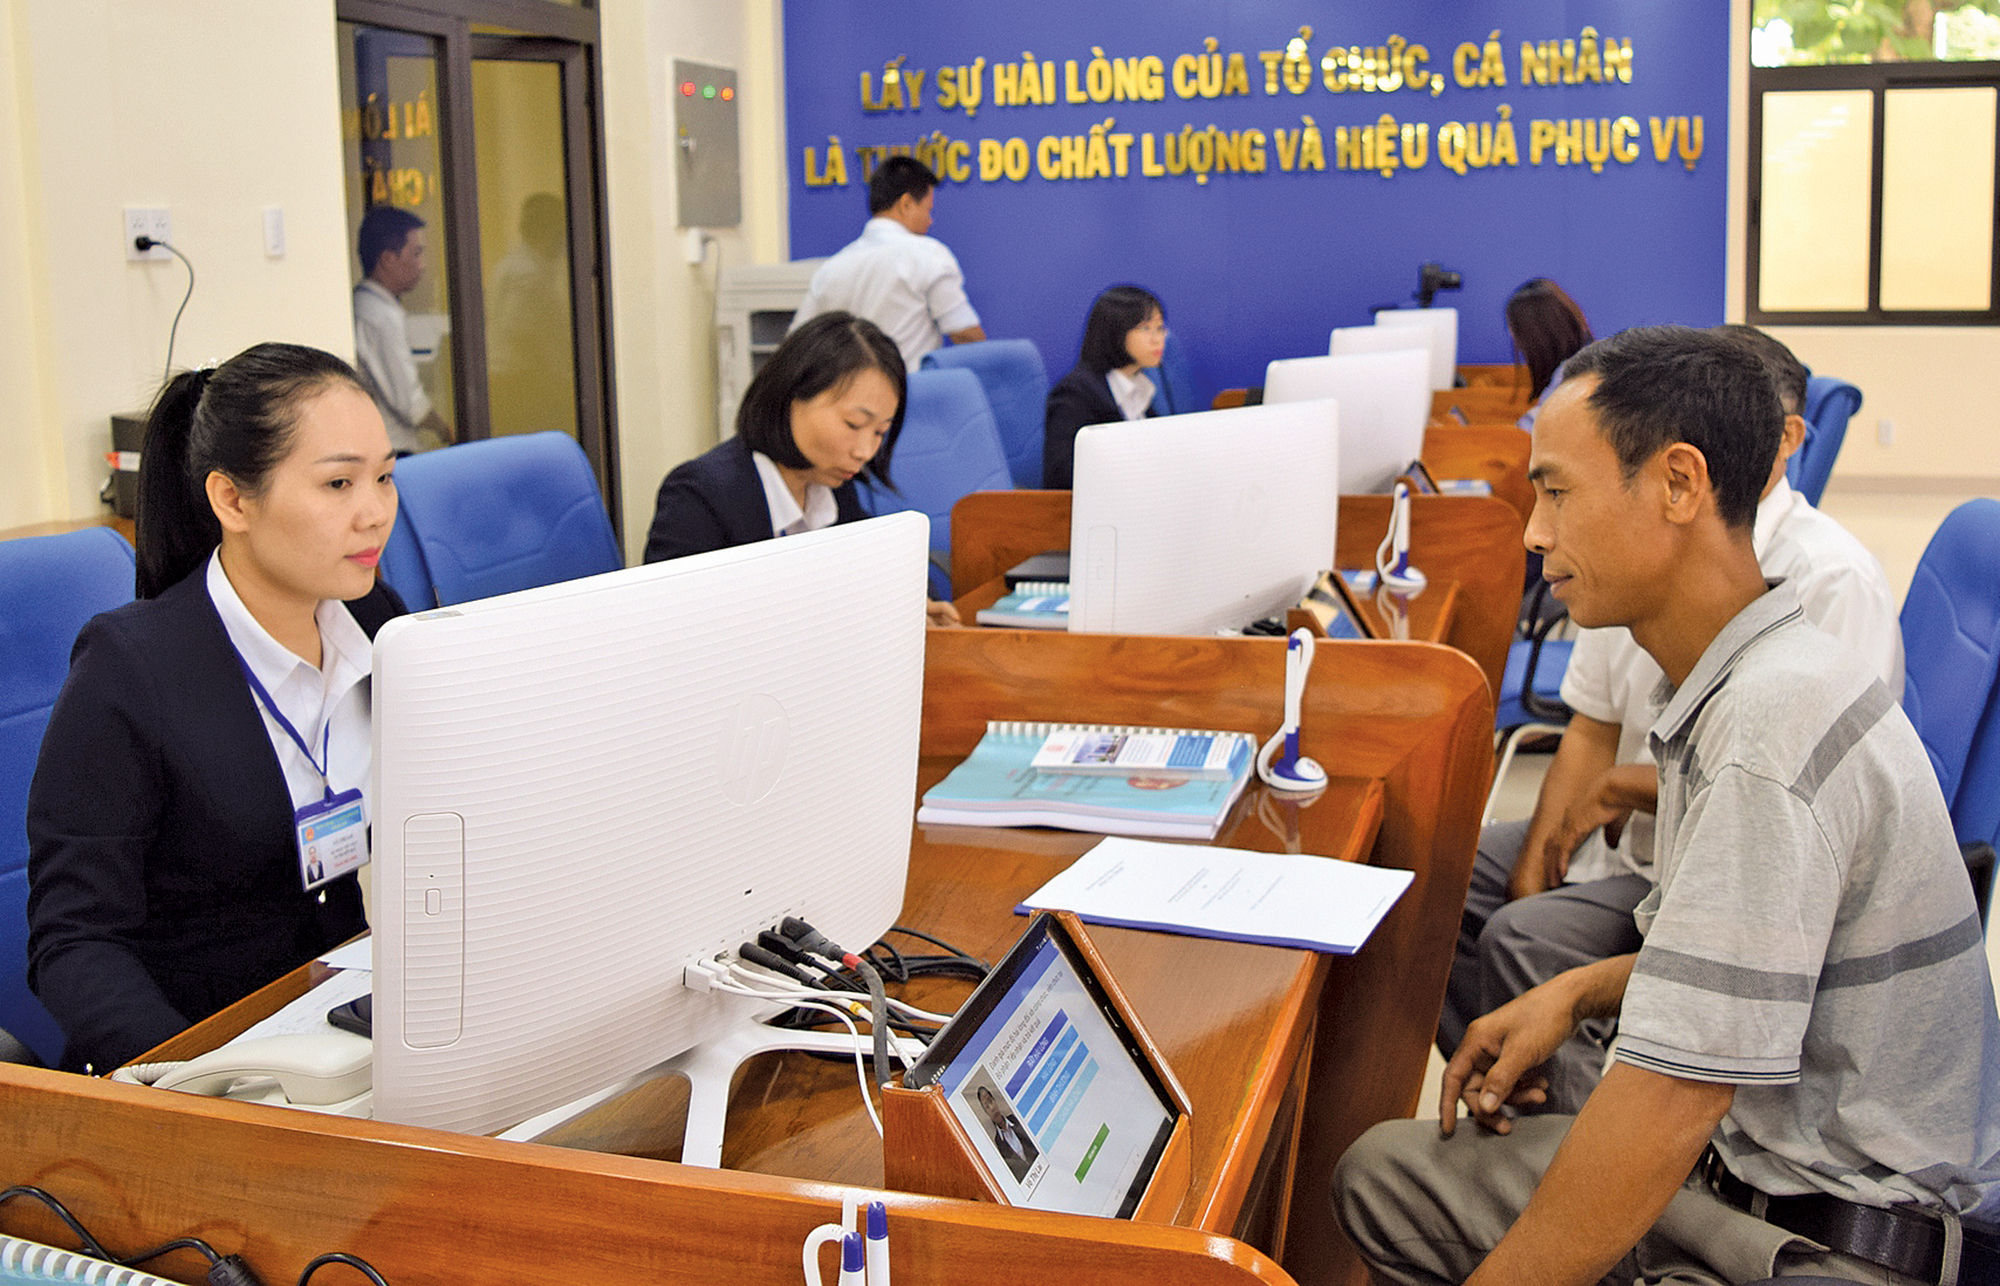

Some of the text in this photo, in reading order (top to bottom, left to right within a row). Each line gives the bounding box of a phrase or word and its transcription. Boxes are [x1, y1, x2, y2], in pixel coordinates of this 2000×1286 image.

[859, 54, 926, 111] LẤY
[936, 56, 985, 117] SỰ
[993, 51, 1056, 106] HÀI
[1064, 46, 1165, 104] LÒNG
[1172, 37, 1250, 99] CỦA
[1259, 25, 1313, 95] TỔ
[1453, 29, 1507, 88] CÁ
[1520, 26, 1634, 85] NHÂN
[804, 135, 848, 186] LÀ
[978, 137, 1030, 182] ĐO
[1036, 117, 1134, 180] CHẤT
[1142, 124, 1267, 185] LƯỢNG
[1274, 115, 1326, 172] VÀ
[1335, 113, 1430, 178] HIỆU
[1437, 104, 1519, 176] QUẢ
[1529, 116, 1641, 174] PHỤC
[1649, 115, 1704, 172] VỤ
